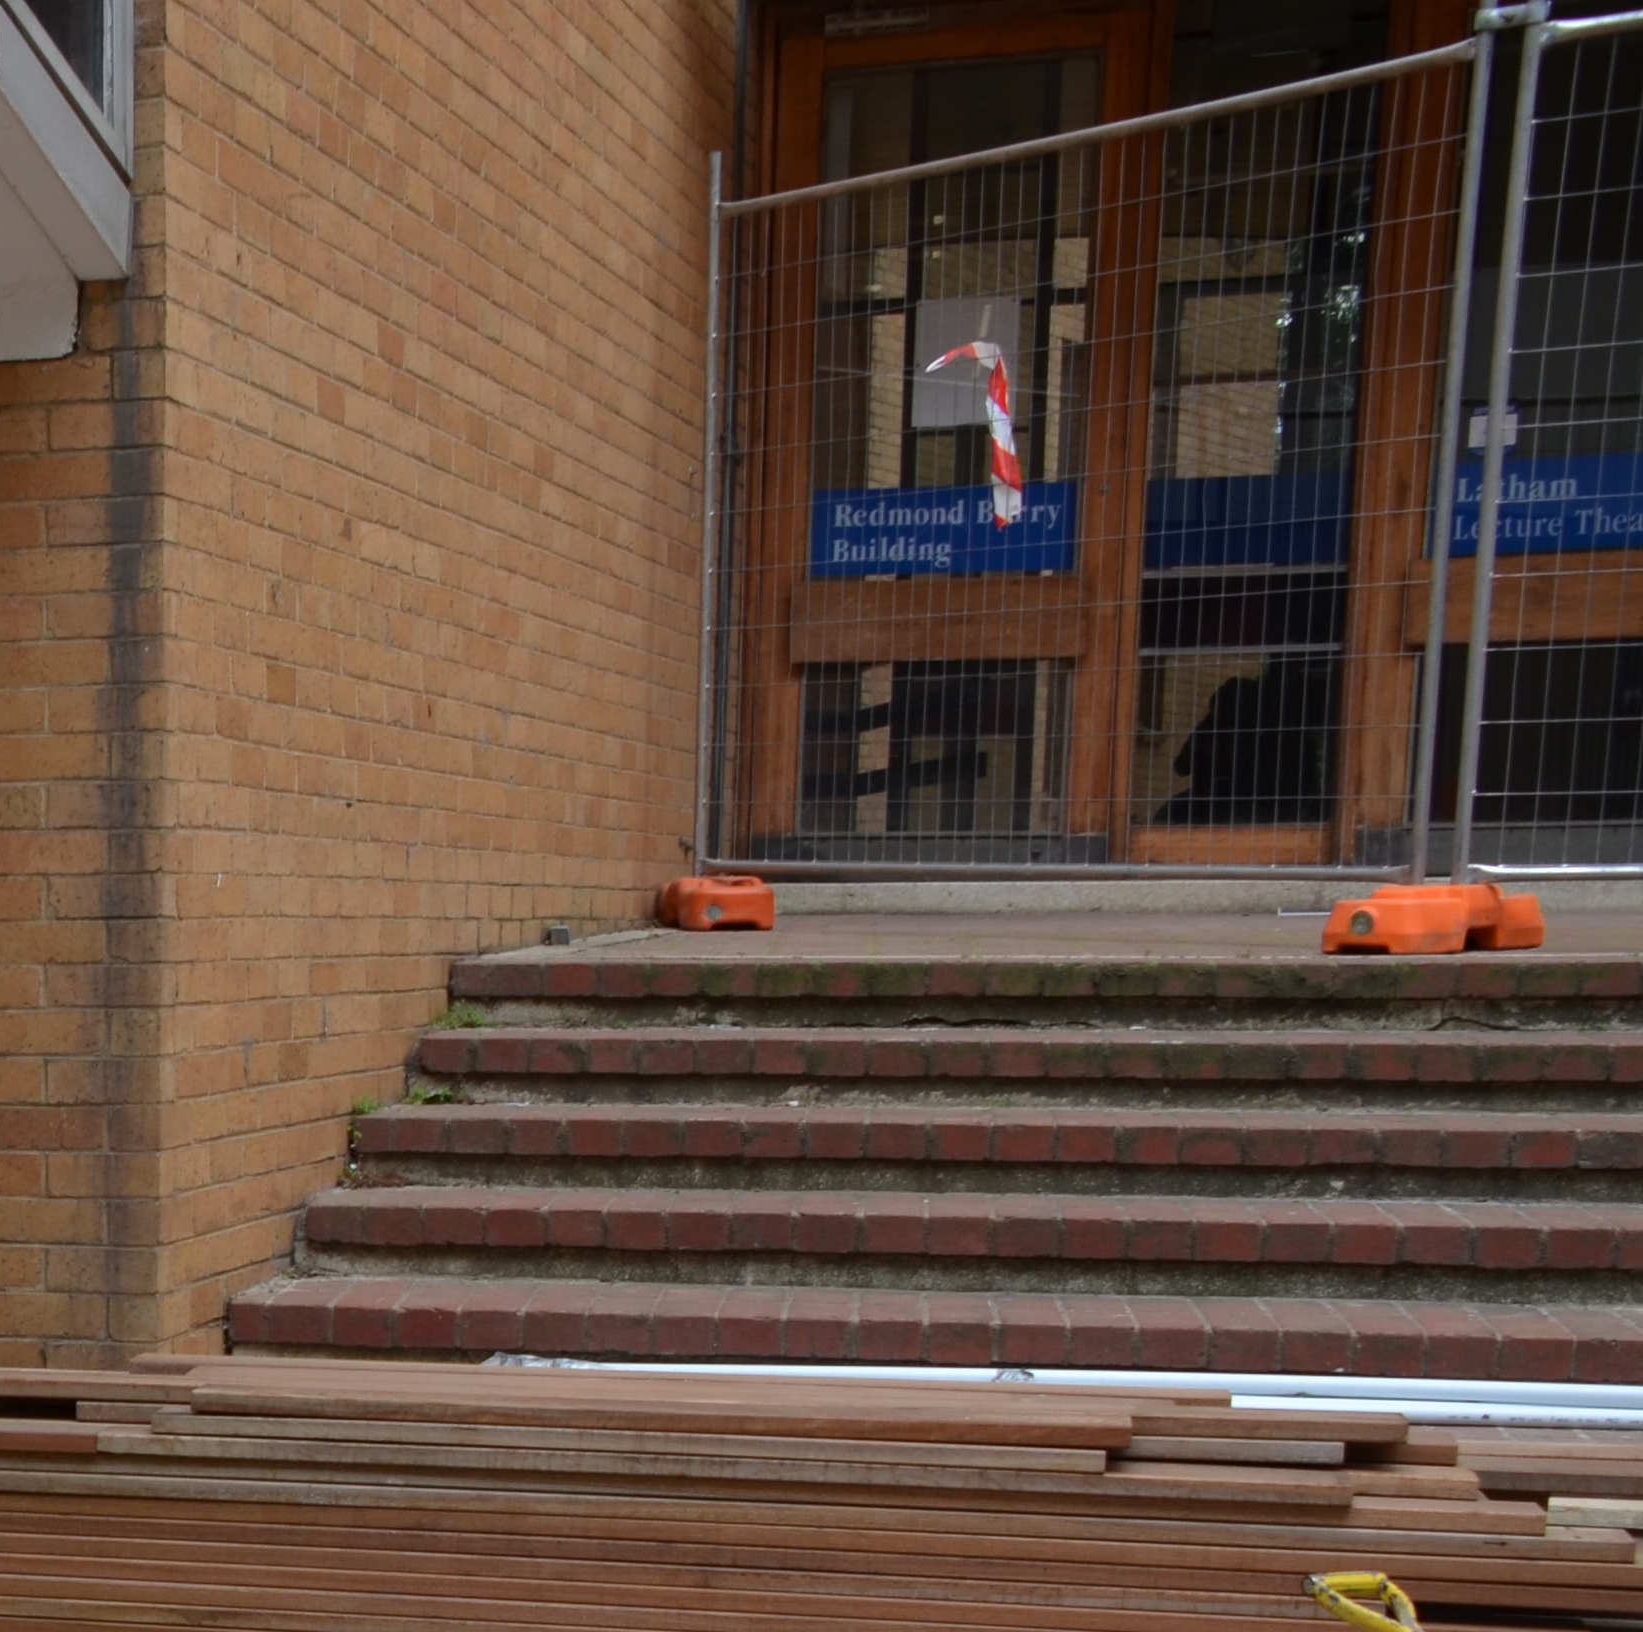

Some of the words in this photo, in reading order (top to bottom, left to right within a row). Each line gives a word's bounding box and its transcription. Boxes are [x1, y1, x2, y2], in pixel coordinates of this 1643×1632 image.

[1457, 473, 1577, 503] Lham
[833, 499, 965, 527] Redmond
[975, 499, 1062, 530] Brry
[1453, 515, 1564, 540] Leture
[832, 536, 953, 568] Building
